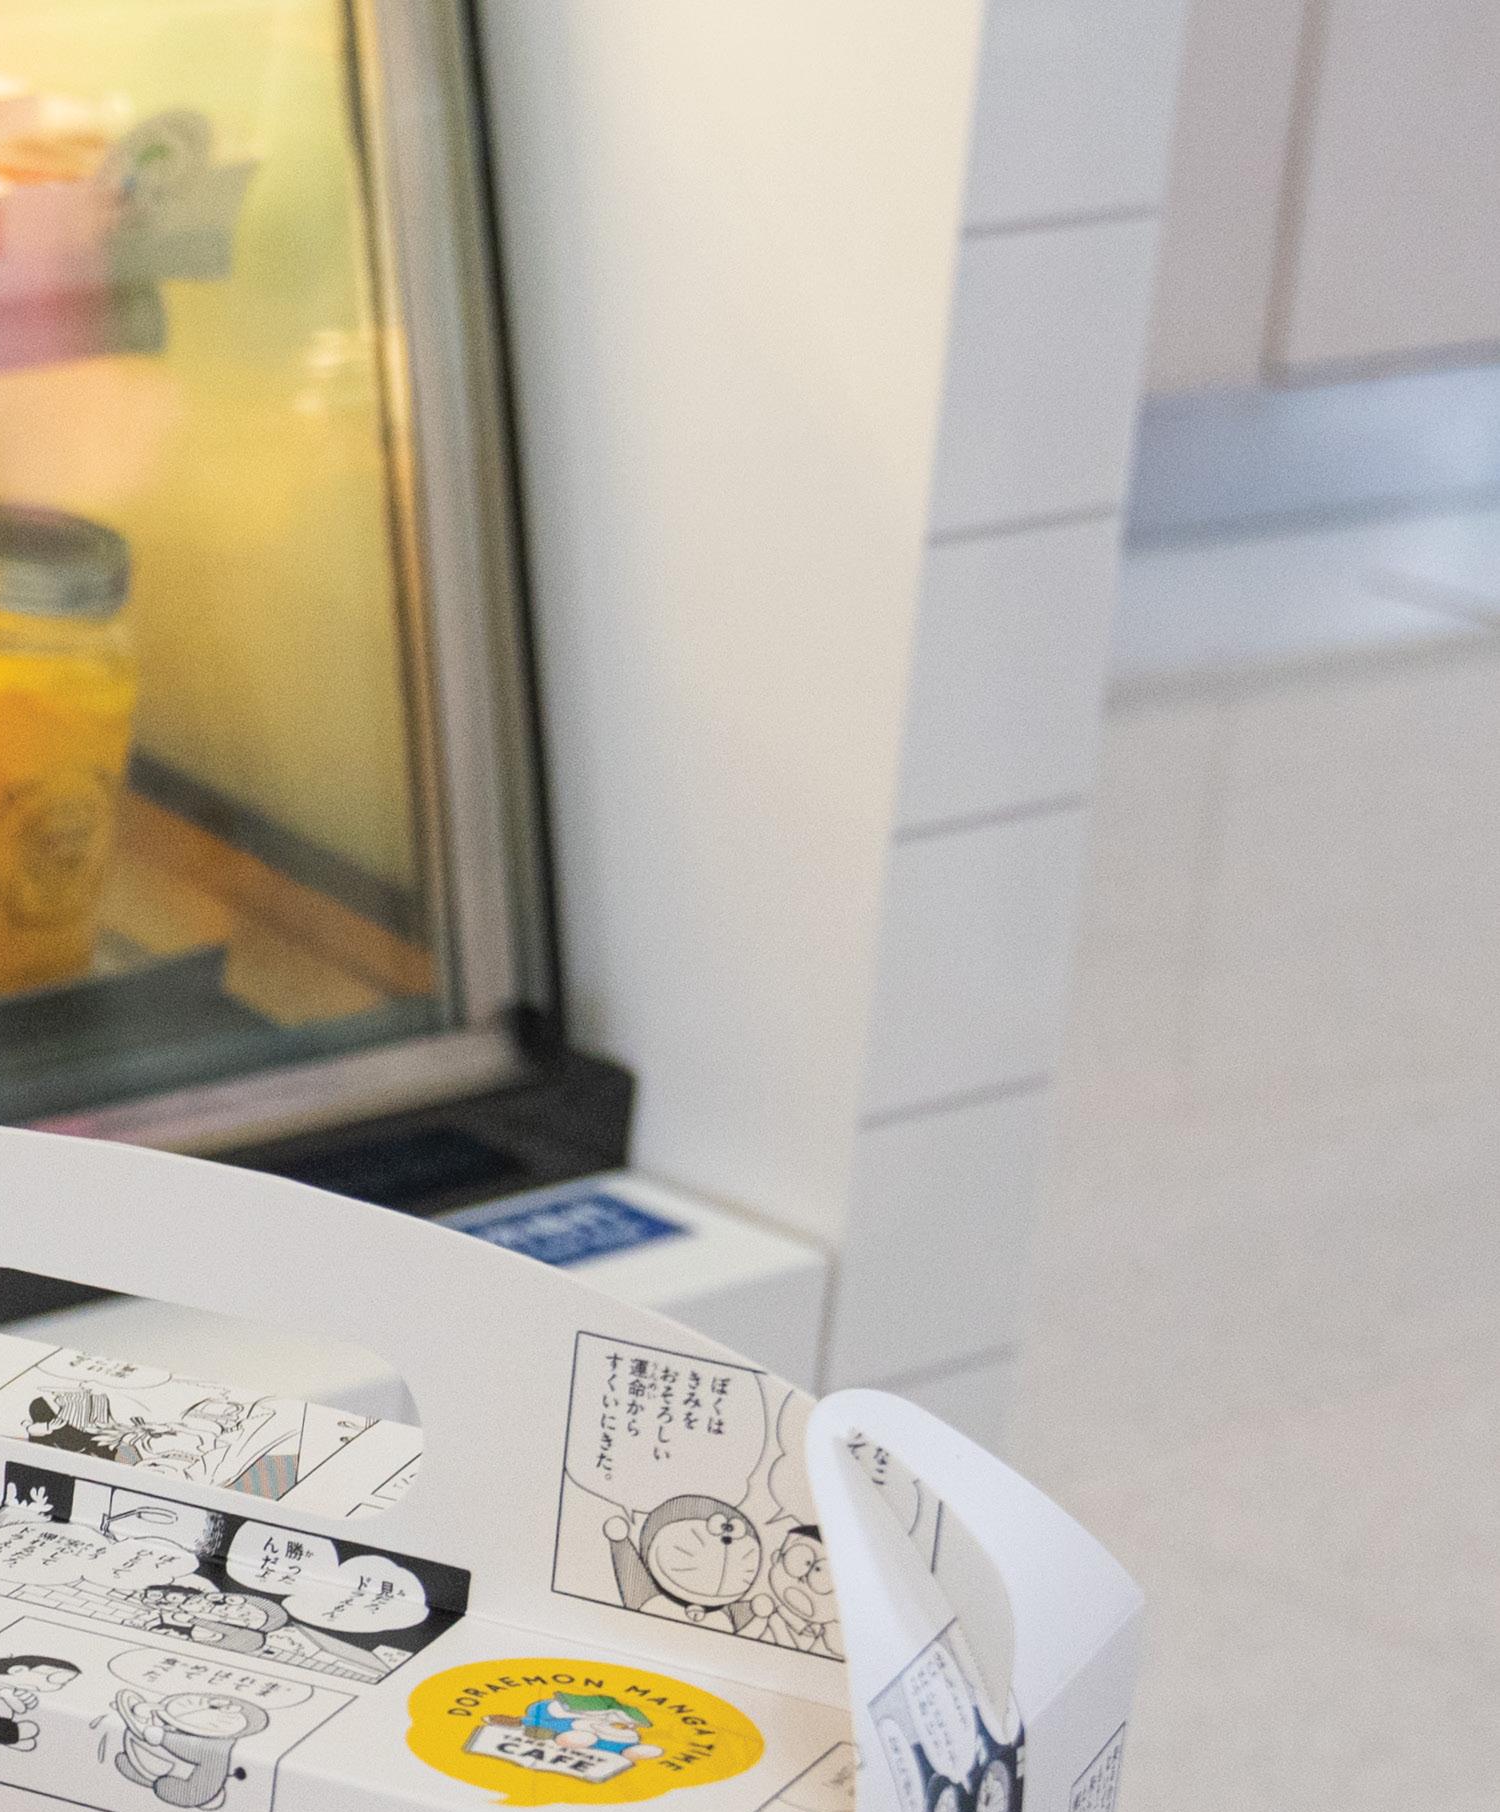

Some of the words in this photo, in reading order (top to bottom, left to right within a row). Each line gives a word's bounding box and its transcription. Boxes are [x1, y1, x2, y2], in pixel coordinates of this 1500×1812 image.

[595, 1352, 624, 1481] すくいにきた。
[626, 1357, 649, 1437] 運命から
[653, 1365, 679, 1461] おそろしい
[682, 1370, 702, 1430] きみを
[706, 1376, 731, 1435] ぼくは
[447, 1673, 604, 1718] DORAEMON
[624, 1684, 716, 1737] MANGA
[496, 1742, 596, 1773] CAFE
[658, 1740, 716, 1772] TIME
